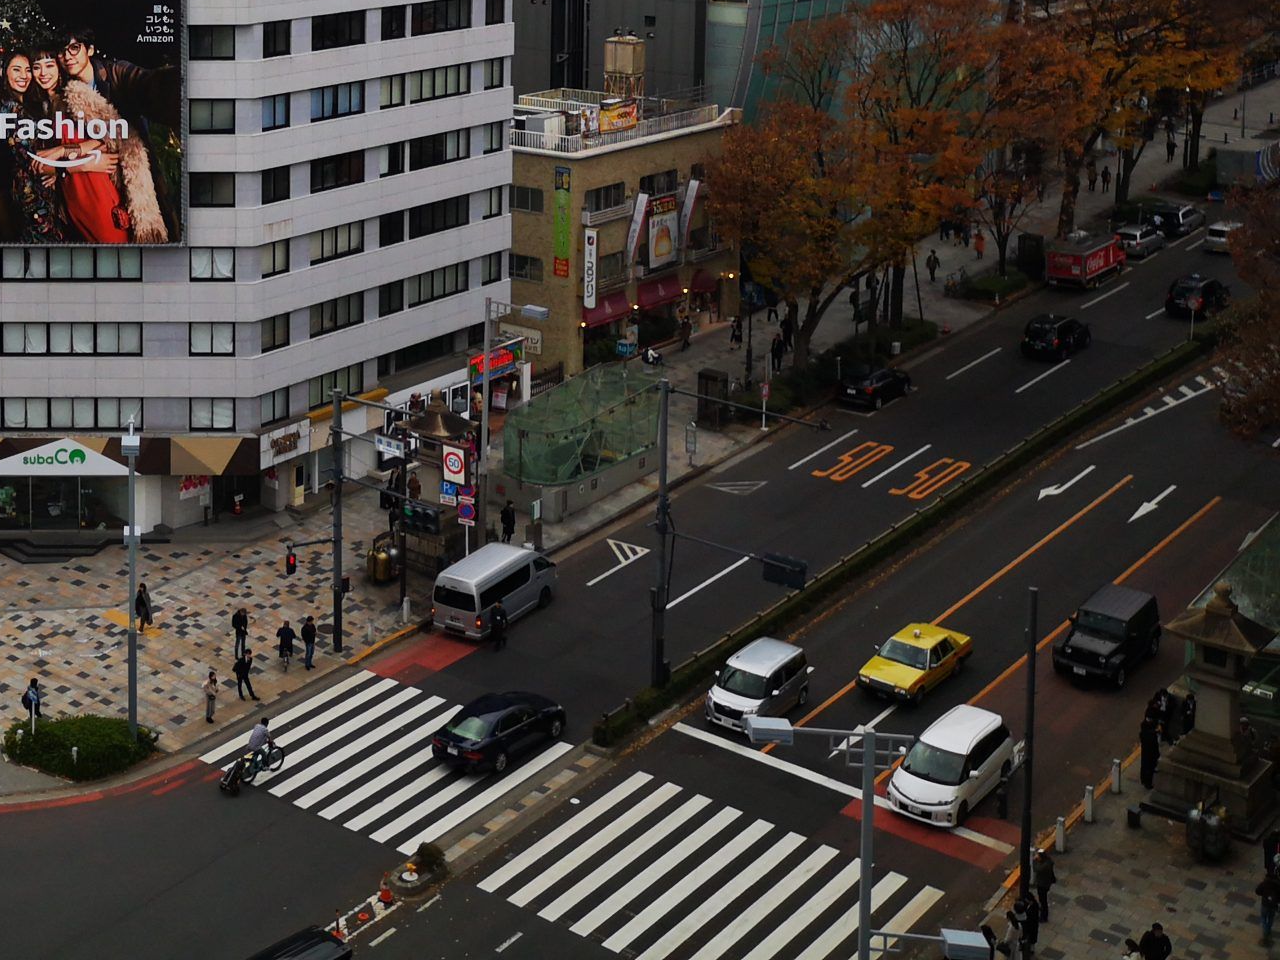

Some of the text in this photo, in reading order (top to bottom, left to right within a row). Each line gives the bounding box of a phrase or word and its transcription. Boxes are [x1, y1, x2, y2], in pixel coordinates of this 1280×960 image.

[136, 34, 174, 43] Amazon
[0, 111, 129, 140] Fashion
[448, 458, 460, 468] 50
[811, 441, 894, 481] 50
[888, 457, 971, 500] 50
